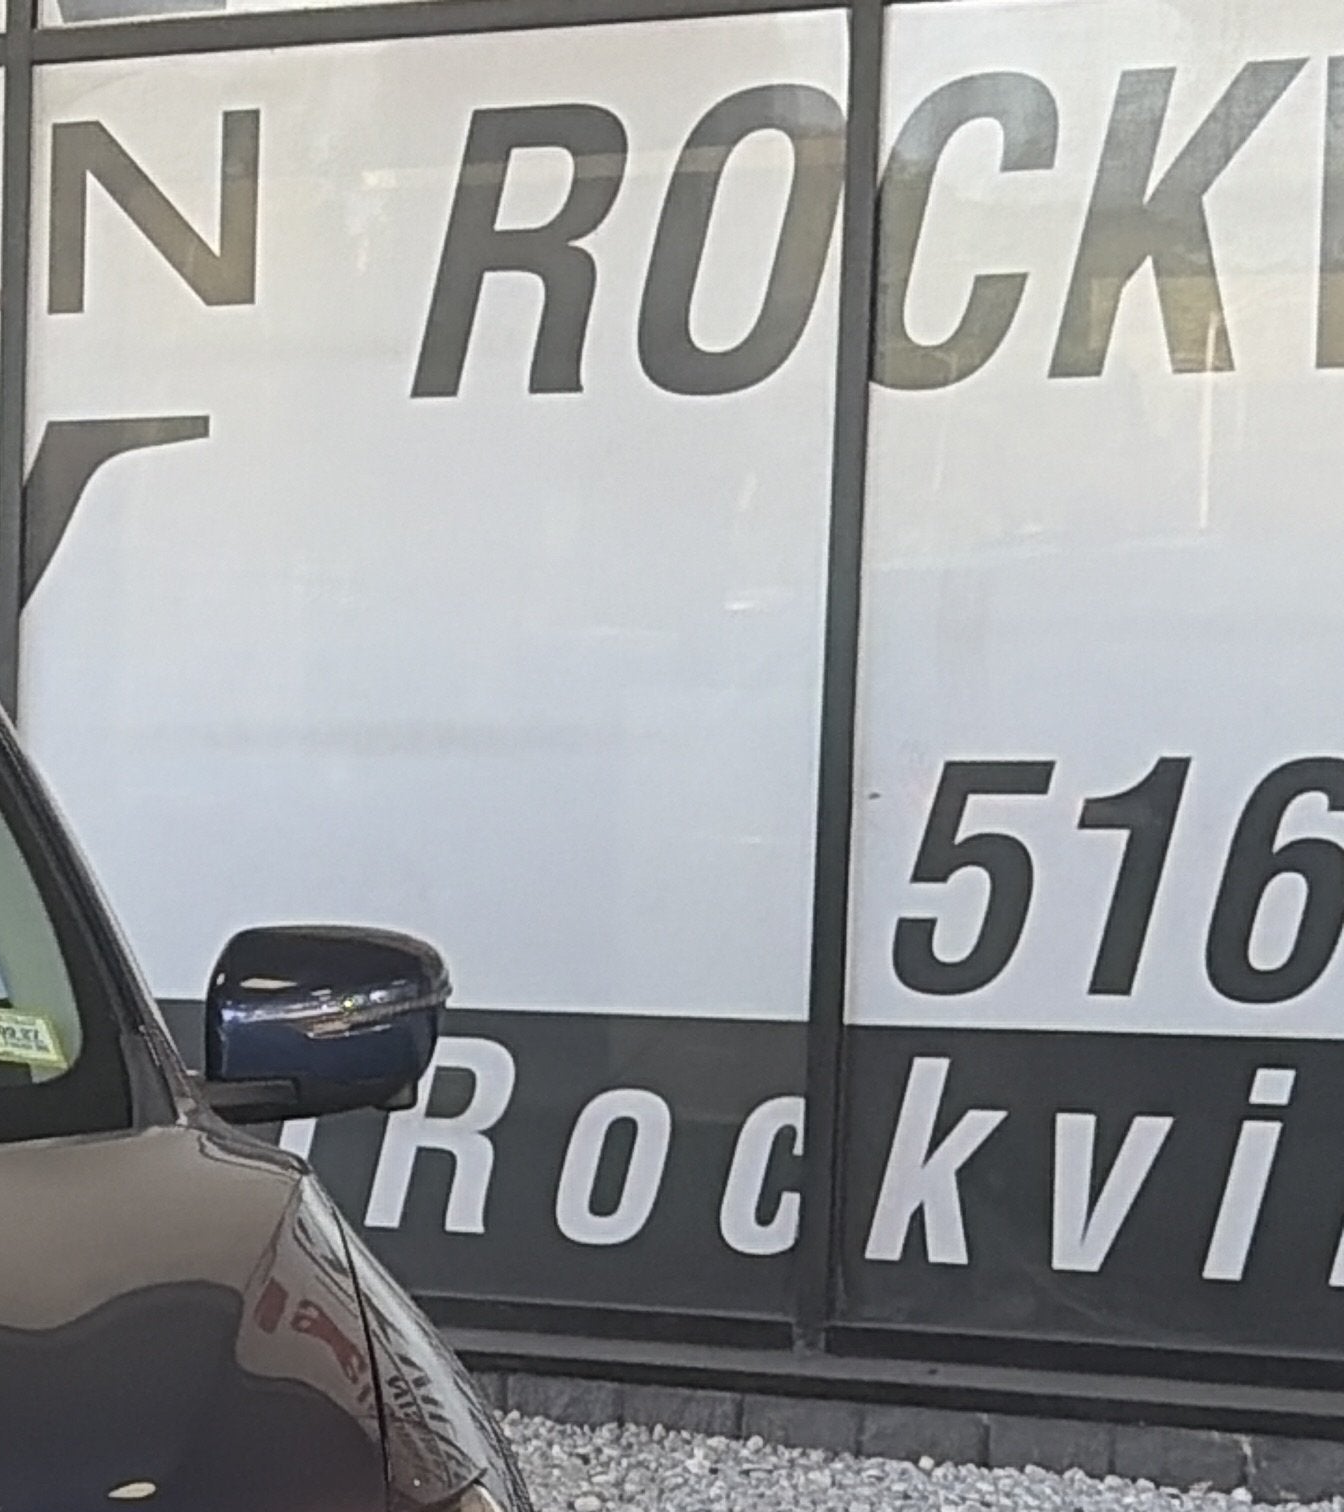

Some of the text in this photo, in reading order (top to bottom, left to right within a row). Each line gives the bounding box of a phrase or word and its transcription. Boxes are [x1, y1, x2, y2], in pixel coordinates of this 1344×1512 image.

[410, 55, 1344, 398] ROCK
[892, 756, 1344, 1004] 516
[279, 1036, 1344, 1287] Rockvi
